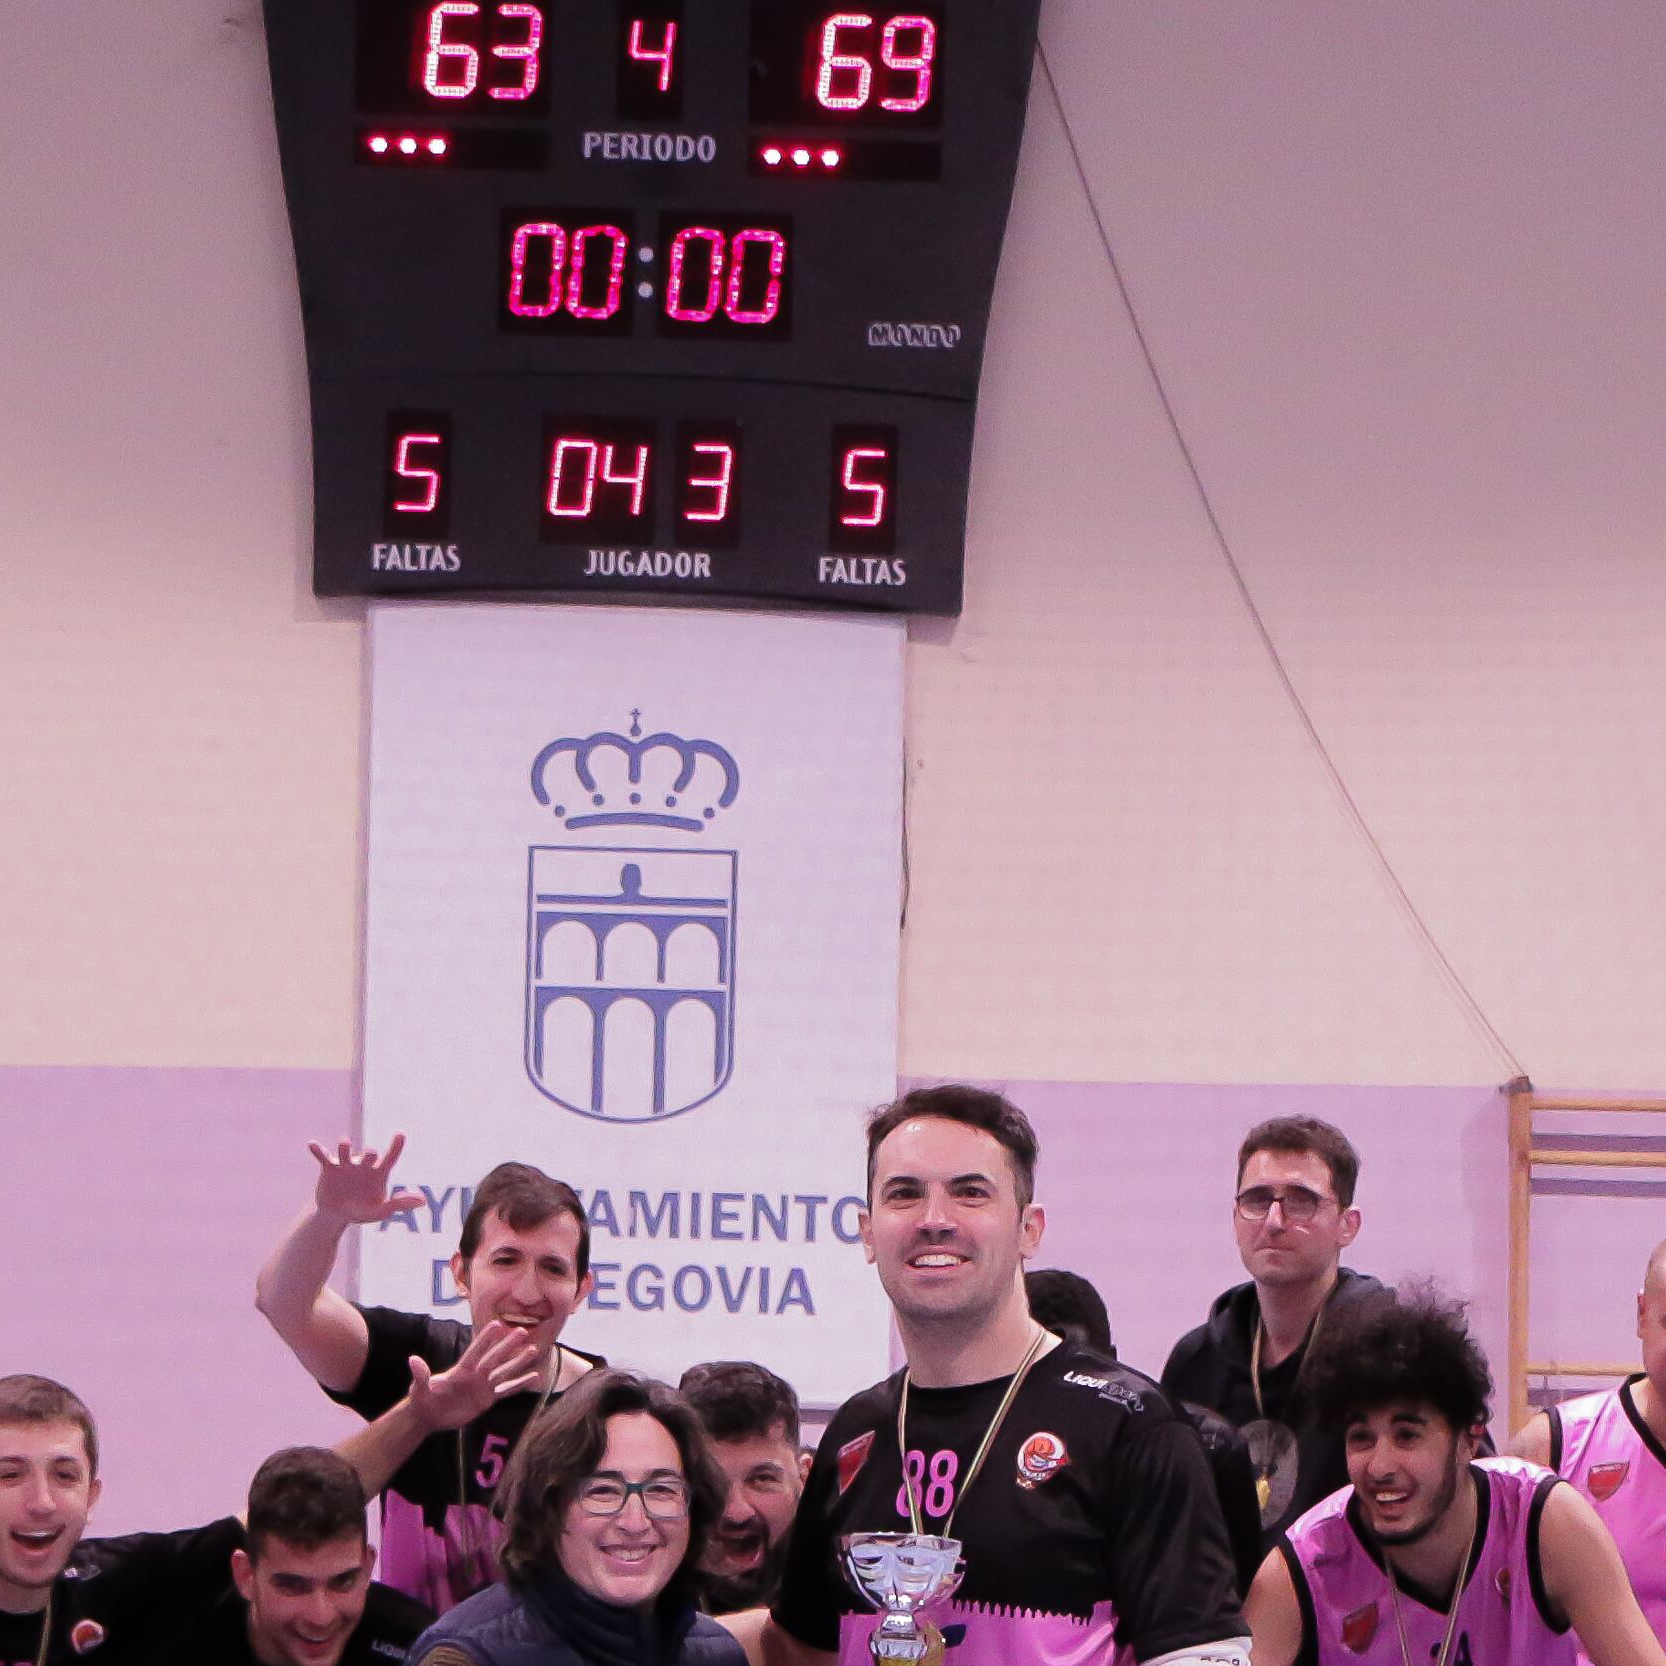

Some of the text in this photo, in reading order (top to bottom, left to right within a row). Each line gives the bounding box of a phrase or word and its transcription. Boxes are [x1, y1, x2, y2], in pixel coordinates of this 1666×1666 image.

[422, 1, 544, 101] 63
[627, 18, 676, 92] 4
[814, 13, 936, 112] 69
[583, 132, 716, 163] PERIODO
[508, 221, 786, 326] 00:00
[393, 433, 442, 514] 5
[545, 437, 733, 522] 04 3
[840, 448, 890, 528] 5
[371, 544, 461, 574] FALTAS
[583, 550, 712, 580] JUGADOR
[818, 556, 907, 588] FALTAS
[379, 1184, 871, 1244] AYAMIENTO
[587, 1261, 815, 1316] EGOVIA
[896, 1449, 958, 1518] 88
